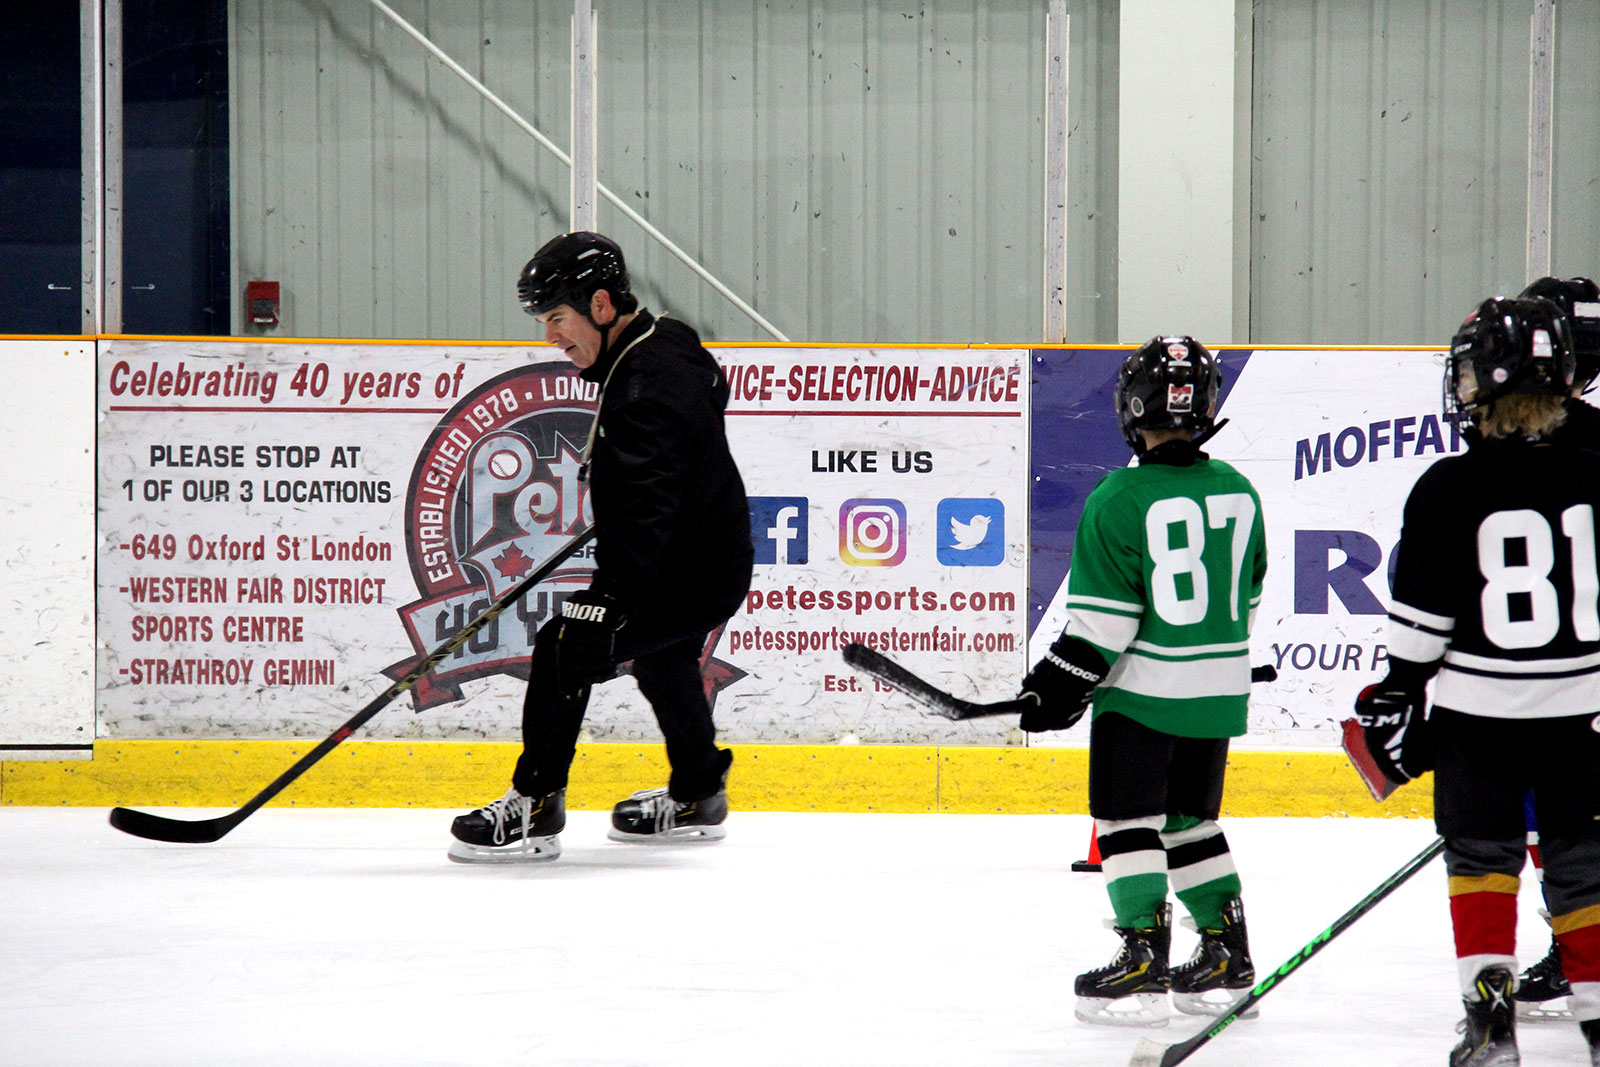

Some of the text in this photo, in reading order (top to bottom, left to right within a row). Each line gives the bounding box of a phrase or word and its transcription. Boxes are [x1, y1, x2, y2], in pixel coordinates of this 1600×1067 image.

[110, 360, 466, 406] Celebrating 40 years of
[148, 443, 362, 470] PLEASE STOP AT
[810, 449, 935, 475] LIKE US
[121, 478, 393, 505] 1 OF OUR 3 LOCATIONS
[419, 427, 473, 583] ESTABLISHED
[464, 387, 520, 434] 1978
[119, 533, 393, 563] -649 Oxford St London
[1146, 493, 1257, 626] 87
[119, 576, 388, 606] -WESTERN FAIR DISTRICT
[1478, 503, 1600, 650] 81
[746, 584, 1016, 616] petessports.com
[131, 615, 305, 643] SPORTS CENTRE
[729, 625, 1015, 656] petessportswesternfair.com
[119, 658, 336, 686] -STRATHROY GEMINI
[1272, 643, 1363, 671] YOUR
[823, 674, 863, 693] Est.
